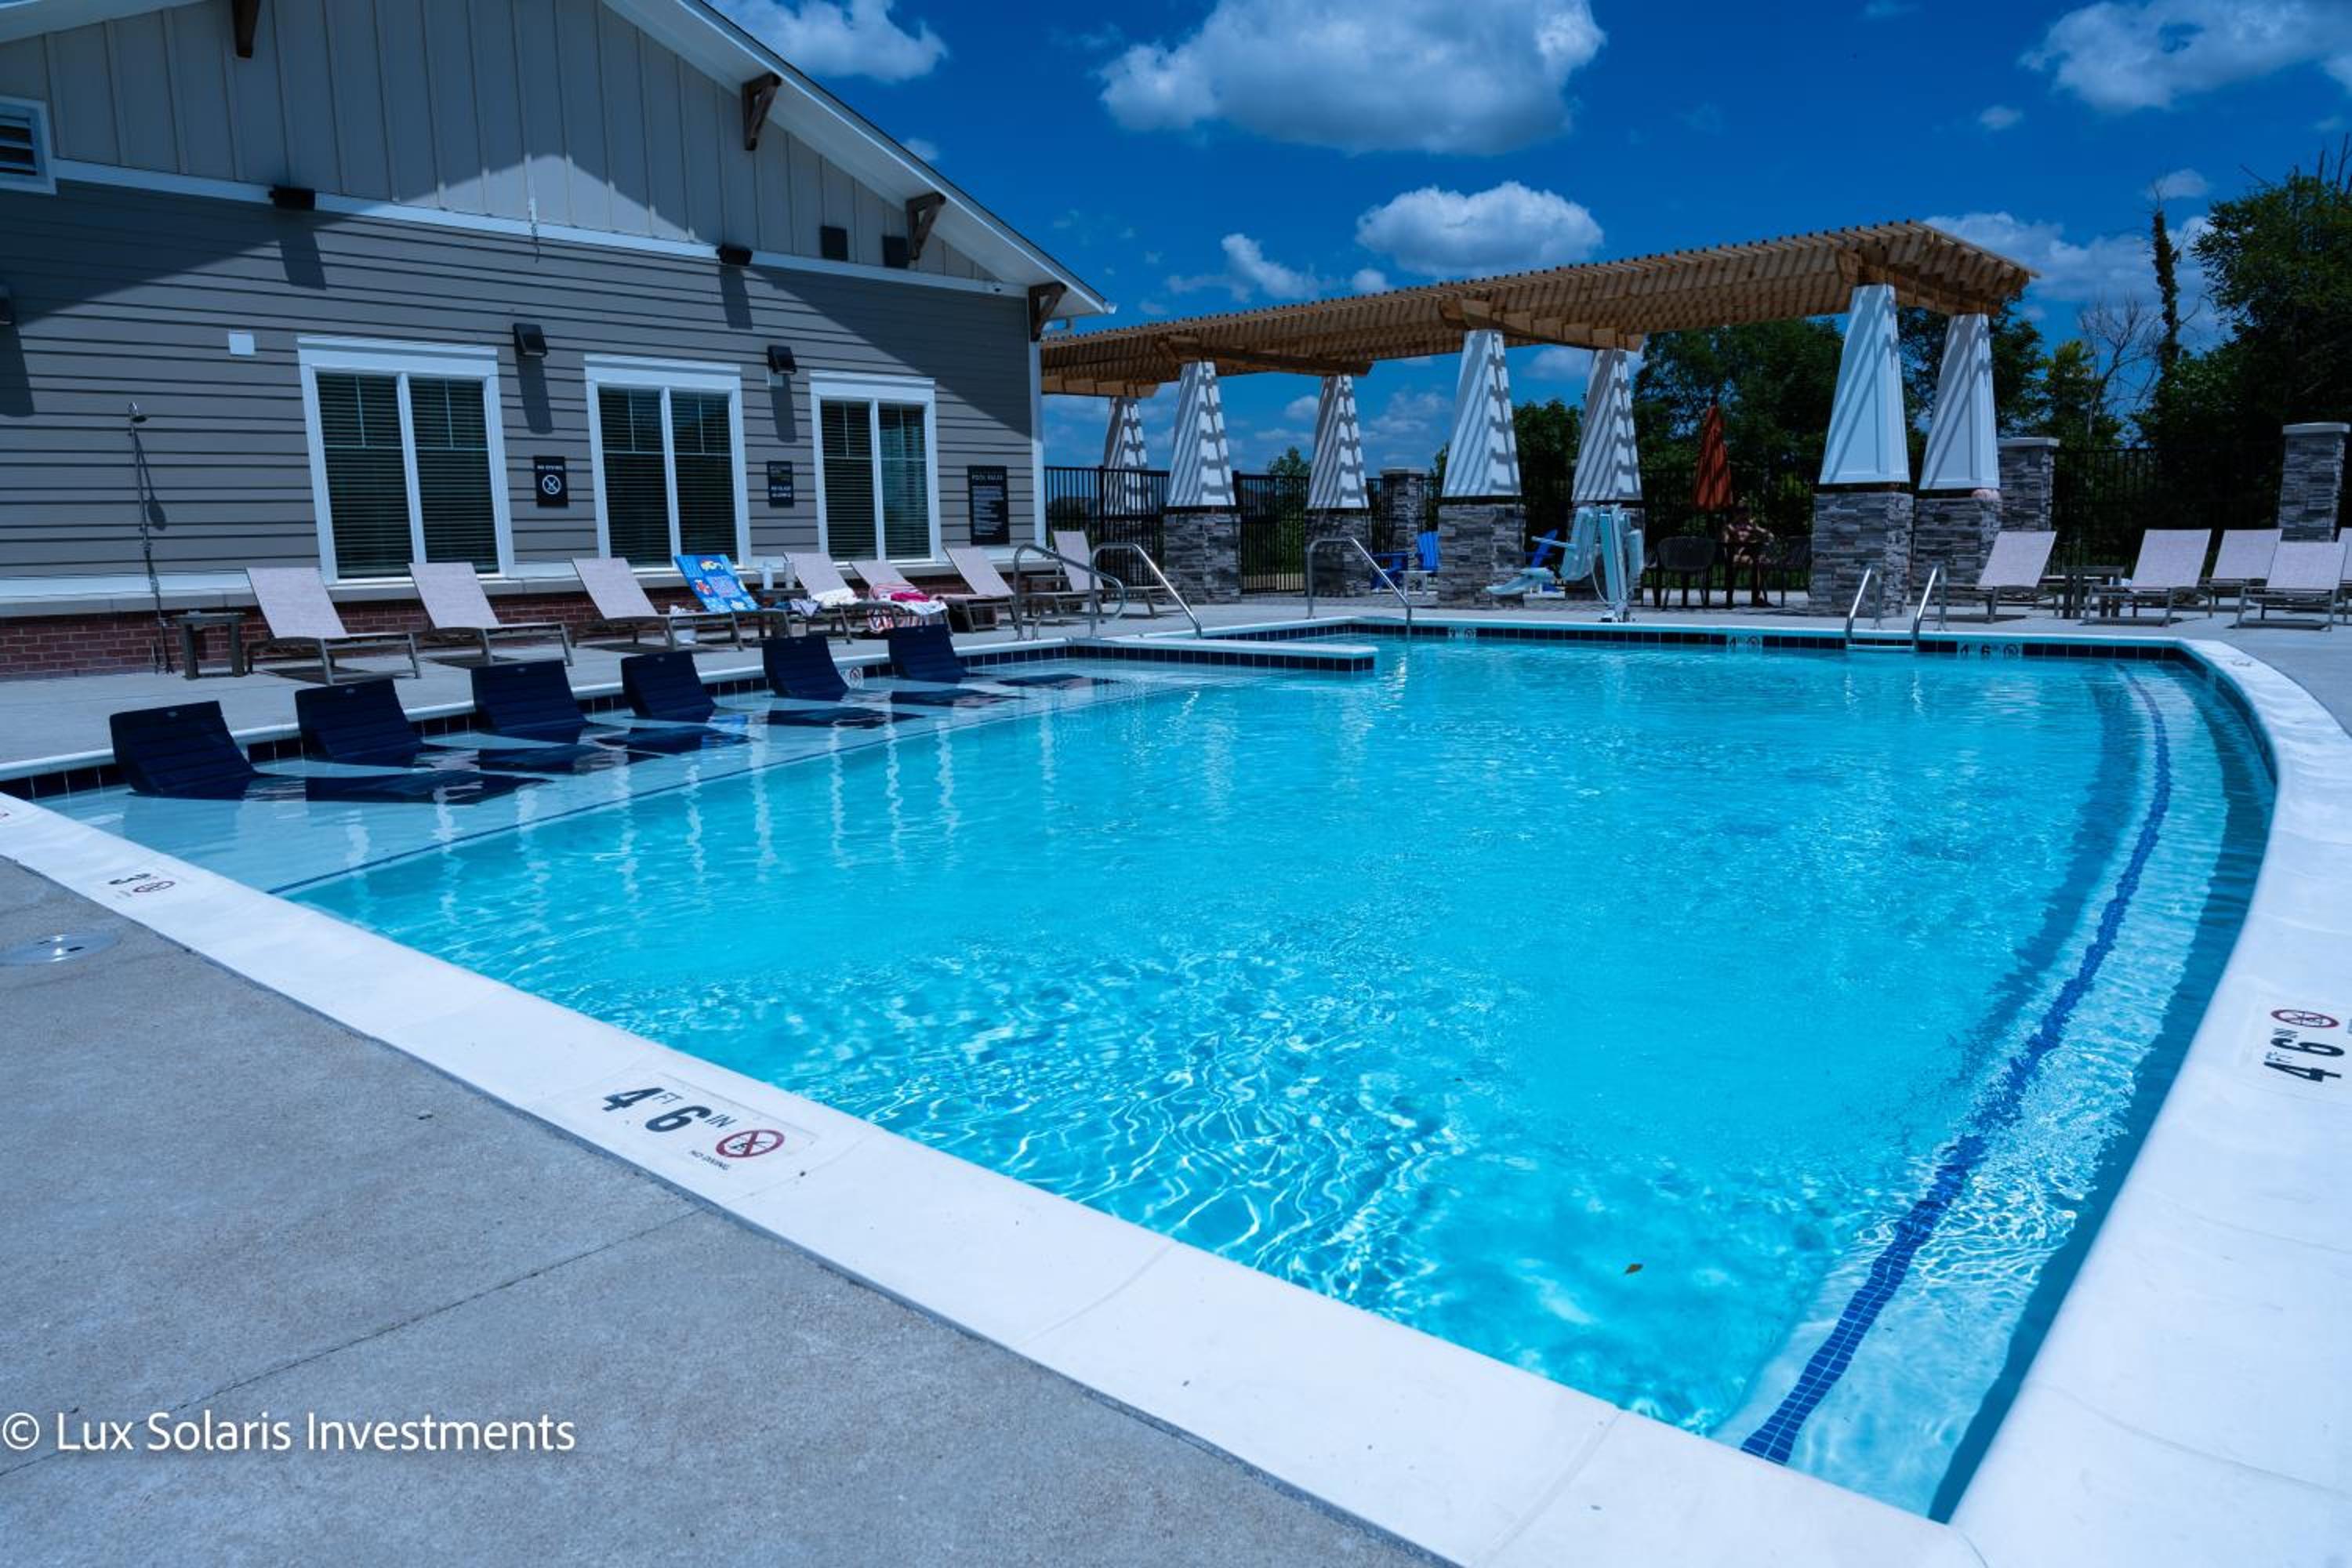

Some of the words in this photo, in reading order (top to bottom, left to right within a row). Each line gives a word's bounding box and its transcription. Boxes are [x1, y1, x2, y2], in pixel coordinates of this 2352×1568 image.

[2270, 1037, 2345, 1058] 6
[2263, 1061, 2342, 1083] 4
[602, 1087, 665, 1112] 4
[652, 1091, 684, 1105] FT
[645, 1105, 712, 1133] 6
[703, 1114, 738, 1129] IN
